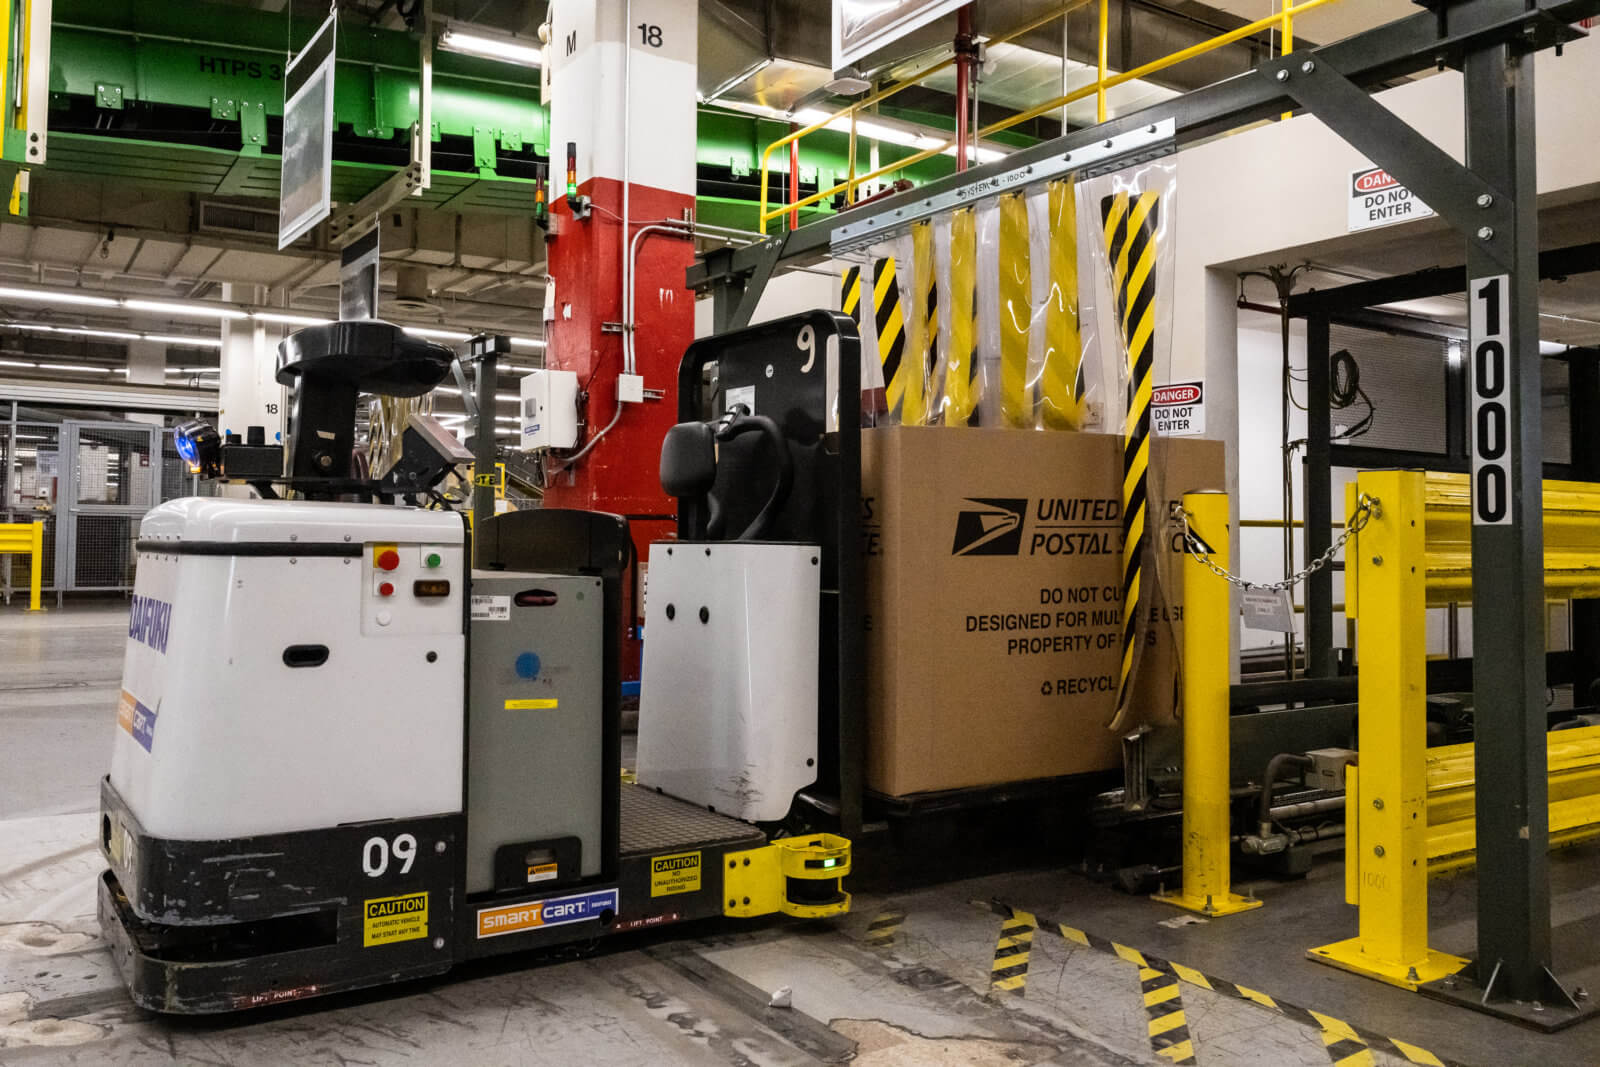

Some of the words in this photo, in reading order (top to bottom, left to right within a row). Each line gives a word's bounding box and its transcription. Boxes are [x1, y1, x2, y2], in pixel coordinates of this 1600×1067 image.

[565, 30, 577, 57] M
[637, 23, 663, 48] 18
[199, 56, 262, 78] HTPS
[1363, 173, 1393, 189] DAN
[1365, 194, 1385, 208] DO
[1369, 202, 1412, 221] ENTER
[796, 324, 816, 374] 9
[1153, 389, 1194, 402] DANGER
[1476, 278, 1506, 523] 1000
[265, 403, 278, 415] 18
[1154, 409, 1169, 420] DO
[1172, 407, 1193, 419] NOT
[1158, 419, 1190, 431] ENTER
[1037, 499, 1119, 521] UNITED
[1030, 533, 1113, 555] POSTAL
[1040, 588, 1063, 604] DO
[1068, 587, 1098, 604] NOT
[1103, 586, 1124, 602] CU
[129, 594, 172, 655] DAIFUKU
[966, 612, 1050, 632] DESIGNED
[1056, 611, 1087, 628] FOR
[1008, 635, 1093, 655] PROPERTY
[1097, 633, 1117, 649] OF
[362, 833, 417, 877] 09
[655, 857, 698, 871] CAUTION
[369, 898, 424, 917] CAUTION
[646, 915, 663, 924] POINT
